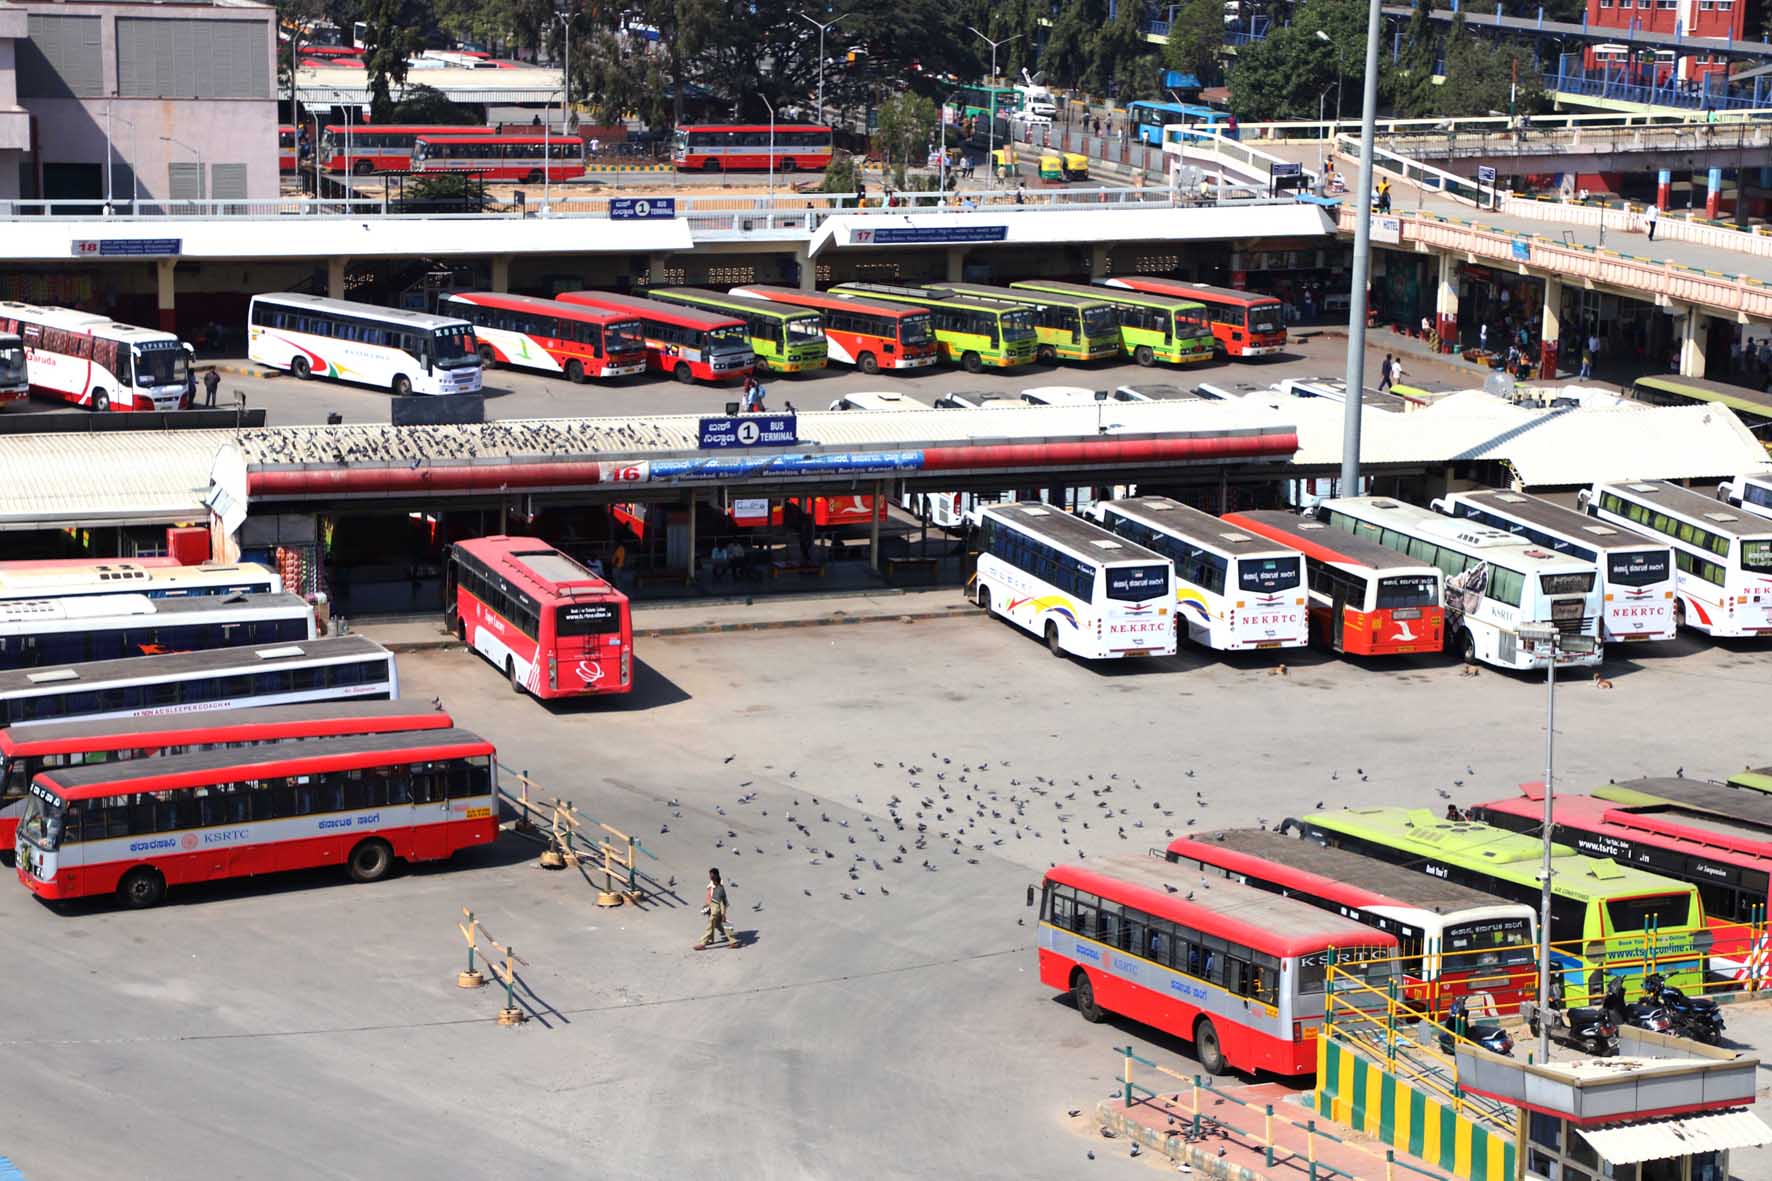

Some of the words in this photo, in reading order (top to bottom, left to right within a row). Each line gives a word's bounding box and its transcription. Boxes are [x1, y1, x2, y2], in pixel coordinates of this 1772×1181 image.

[1383, 220, 1398, 231] HOTEL
[856, 231, 871, 240] 17
[80, 242, 97, 251] 18
[25, 349, 56, 366] Garuda
[770, 421, 784, 431] BUS
[760, 432, 794, 441] TERMINAL
[613, 467, 640, 481] 16
[1613, 607, 1664, 617] NEKRTC
[1242, 614, 1297, 625] NEKRTC
[204, 829, 249, 843] KSRTC
[1301, 950, 1387, 967] KSRTC
